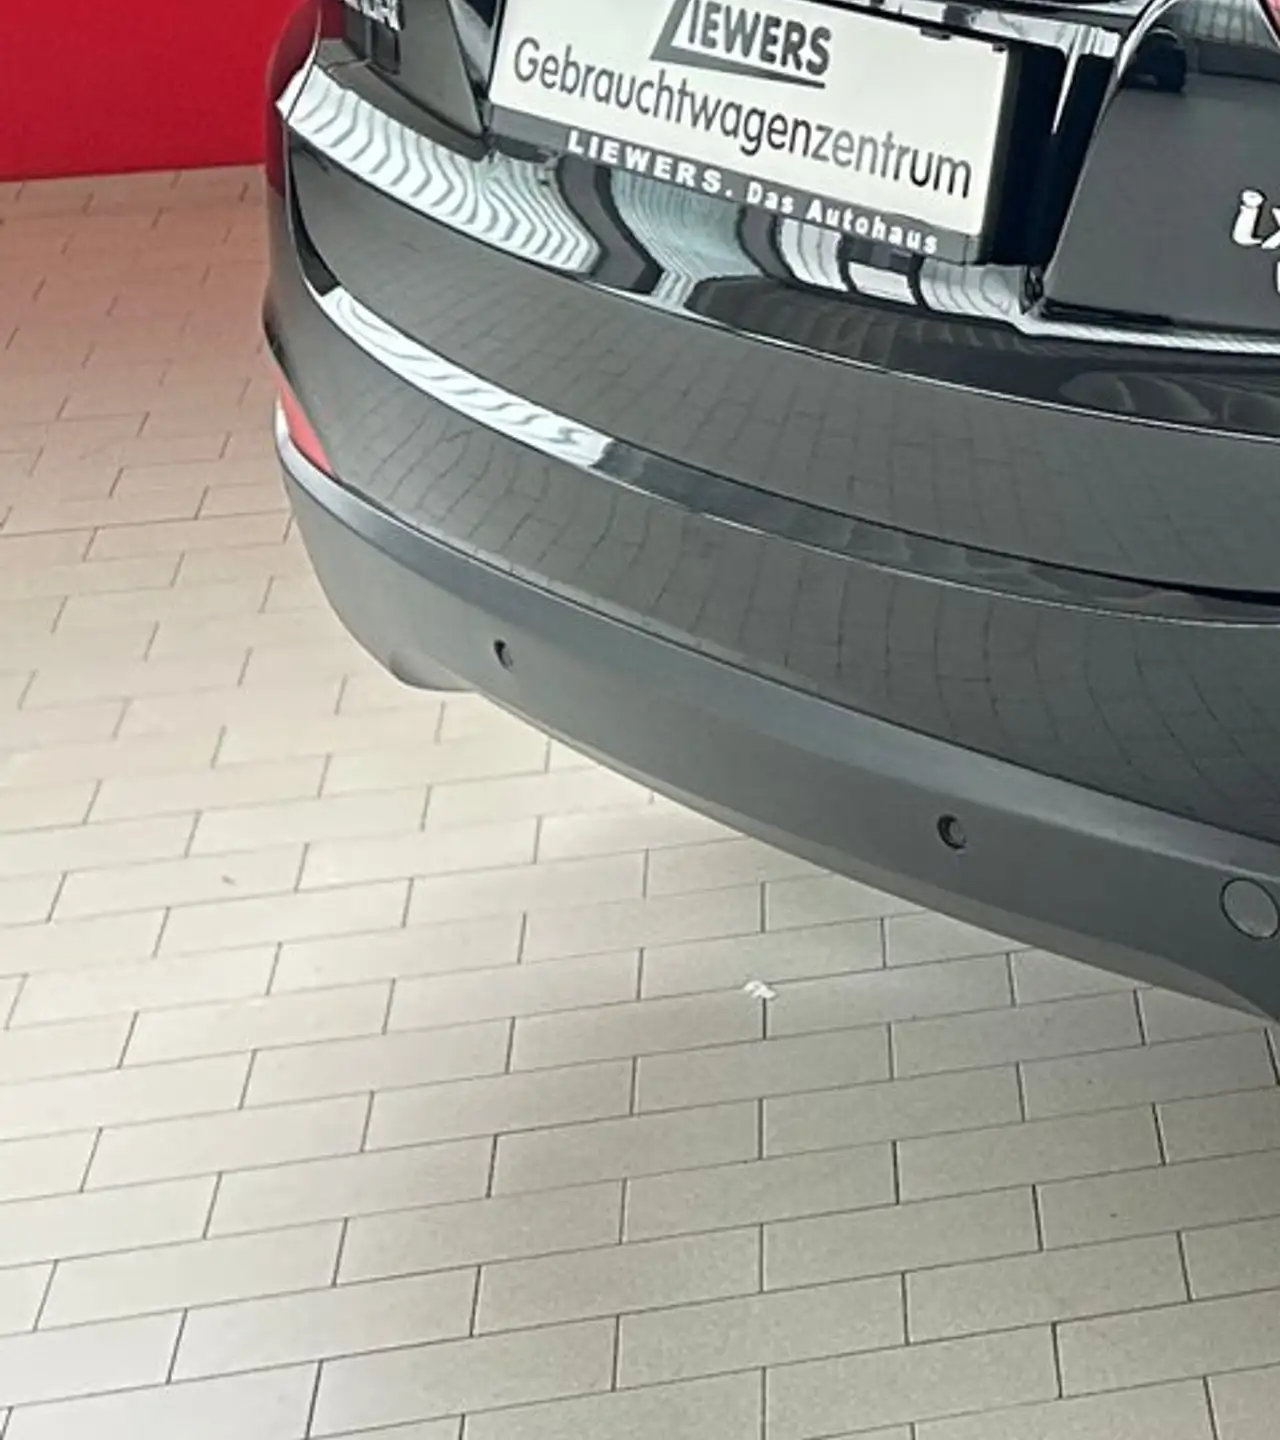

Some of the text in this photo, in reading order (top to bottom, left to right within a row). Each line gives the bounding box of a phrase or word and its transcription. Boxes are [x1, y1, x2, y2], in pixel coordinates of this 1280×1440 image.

[513, 36, 973, 199] Gebrauchtwagenzentrum
[567, 130, 939, 254] LIEWERS. Das Autohaus
